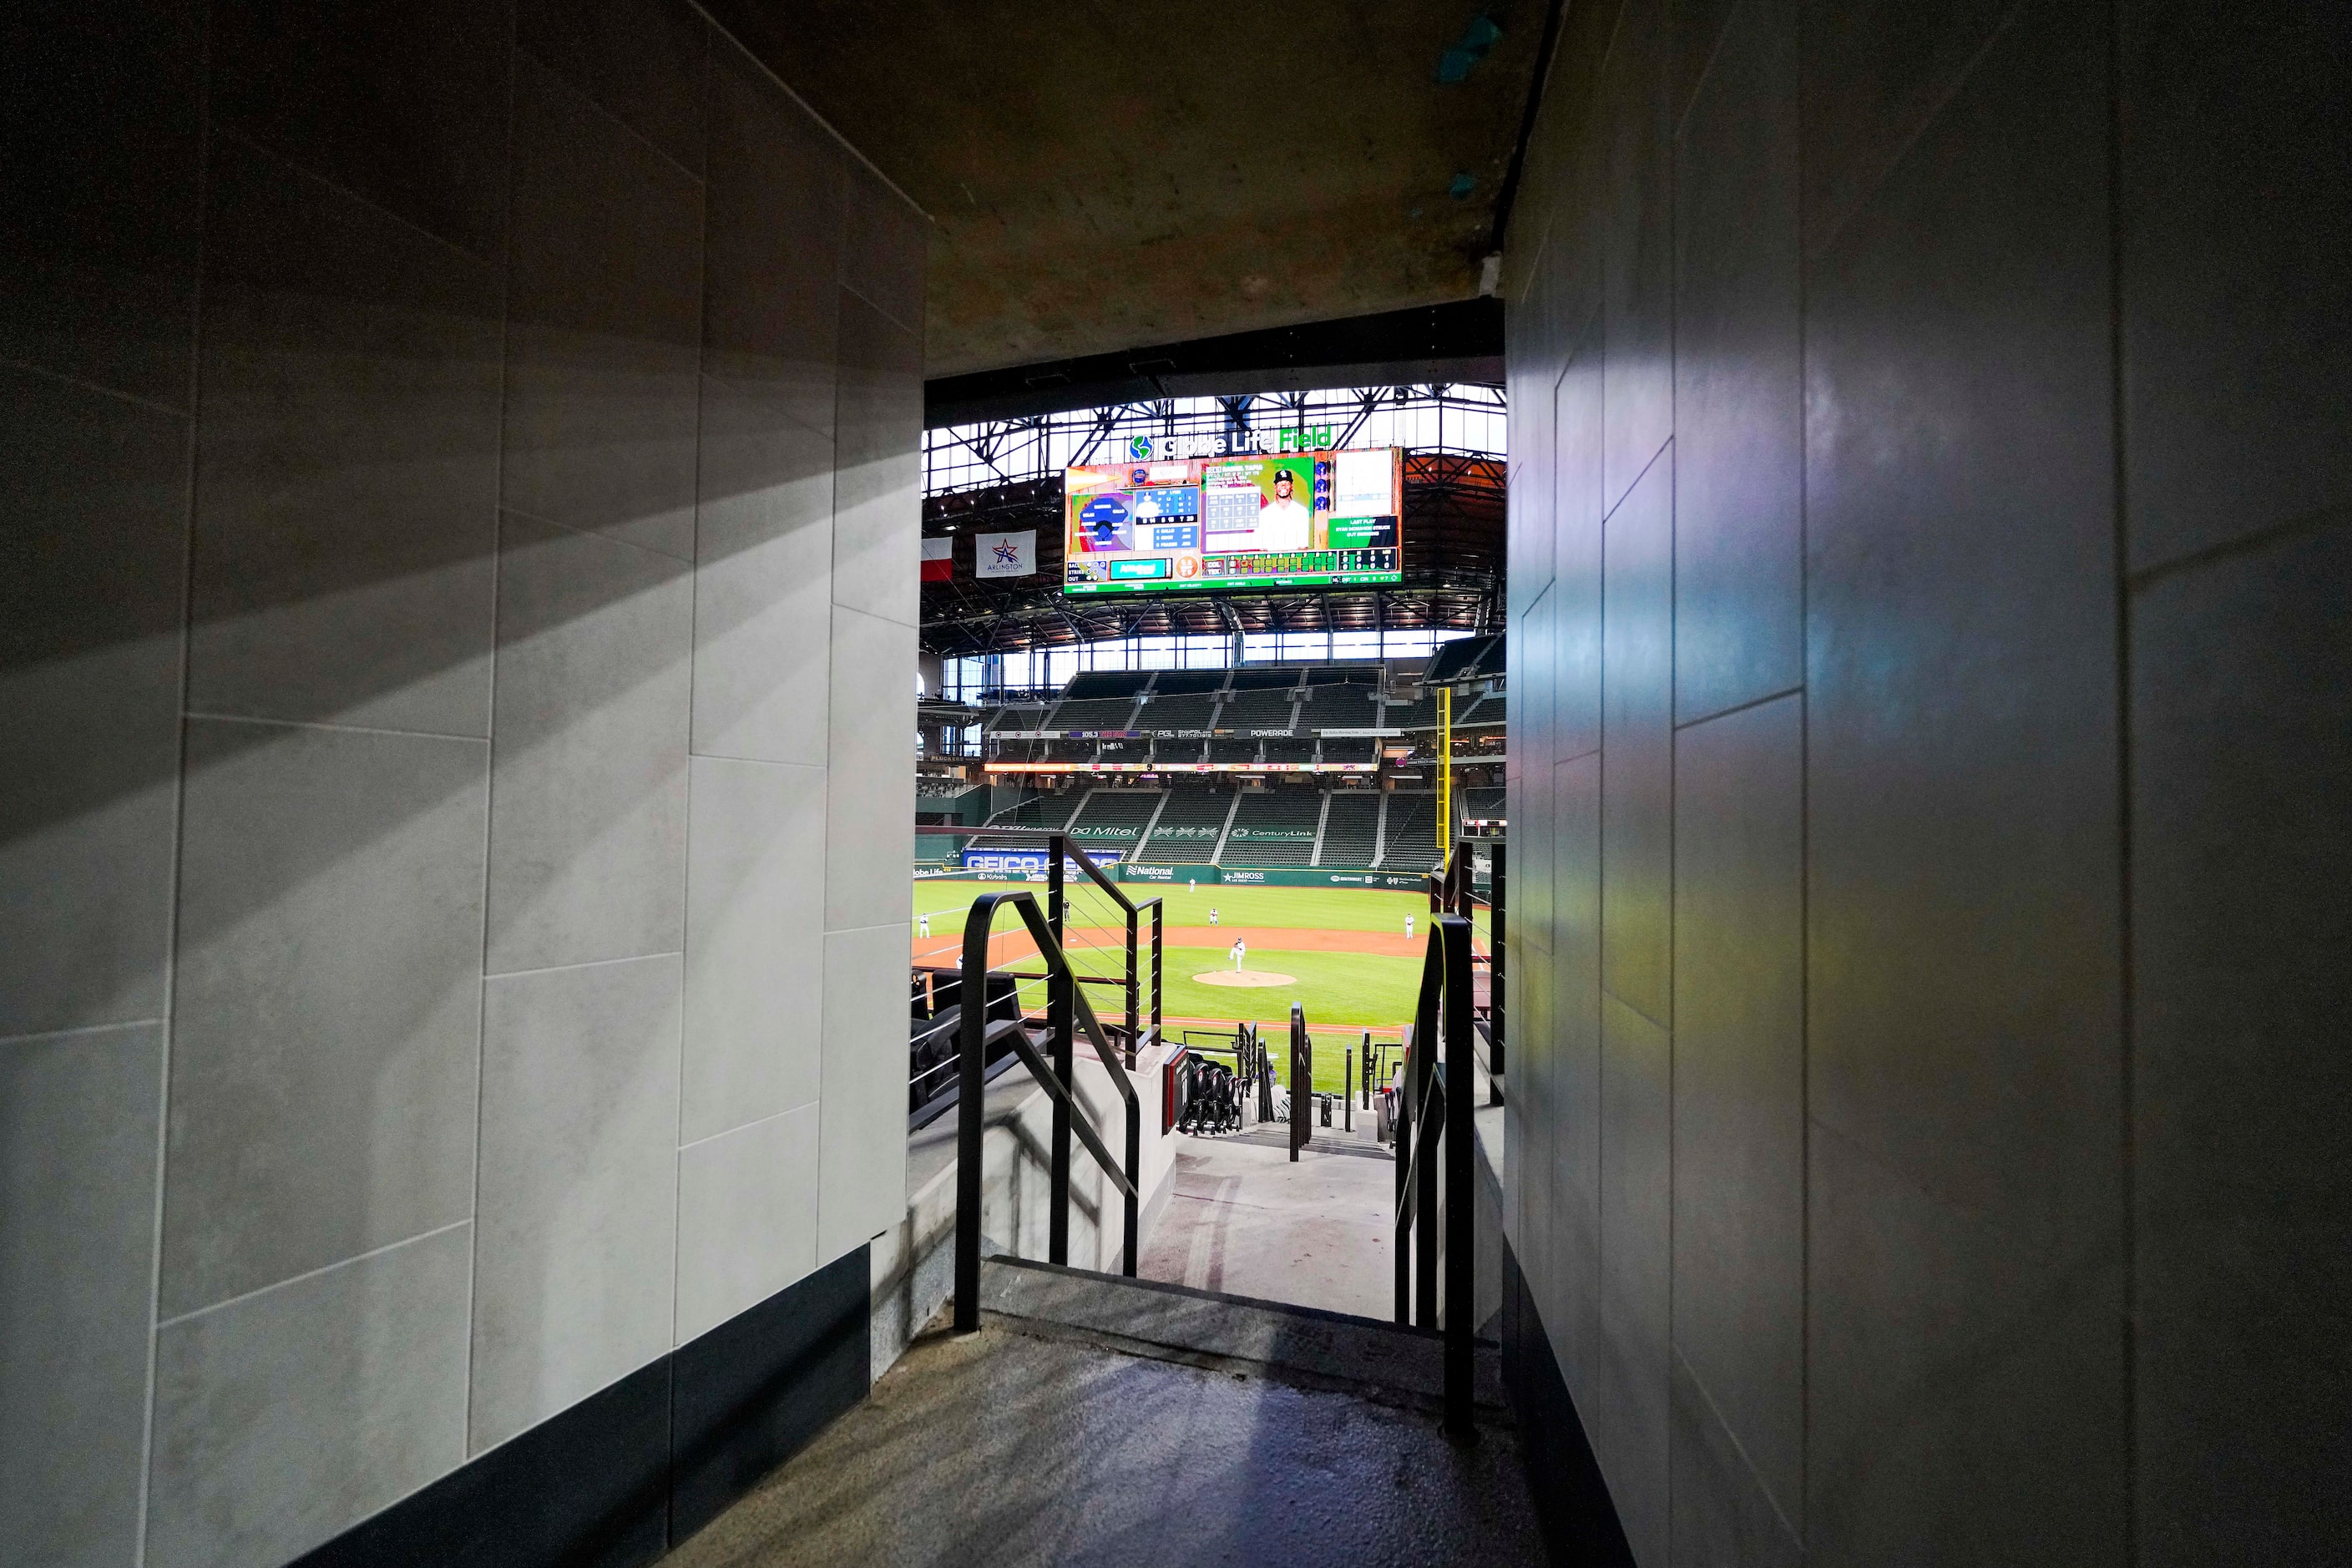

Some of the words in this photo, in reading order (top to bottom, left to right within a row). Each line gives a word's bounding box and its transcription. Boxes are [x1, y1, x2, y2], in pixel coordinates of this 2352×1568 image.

[1162, 434, 1227, 456] Globe
[1232, 429, 1272, 453] Life
[1280, 425, 1332, 449] Field
[1094, 827, 1137, 836] Mitel
[967, 856, 1039, 873] GEICO
